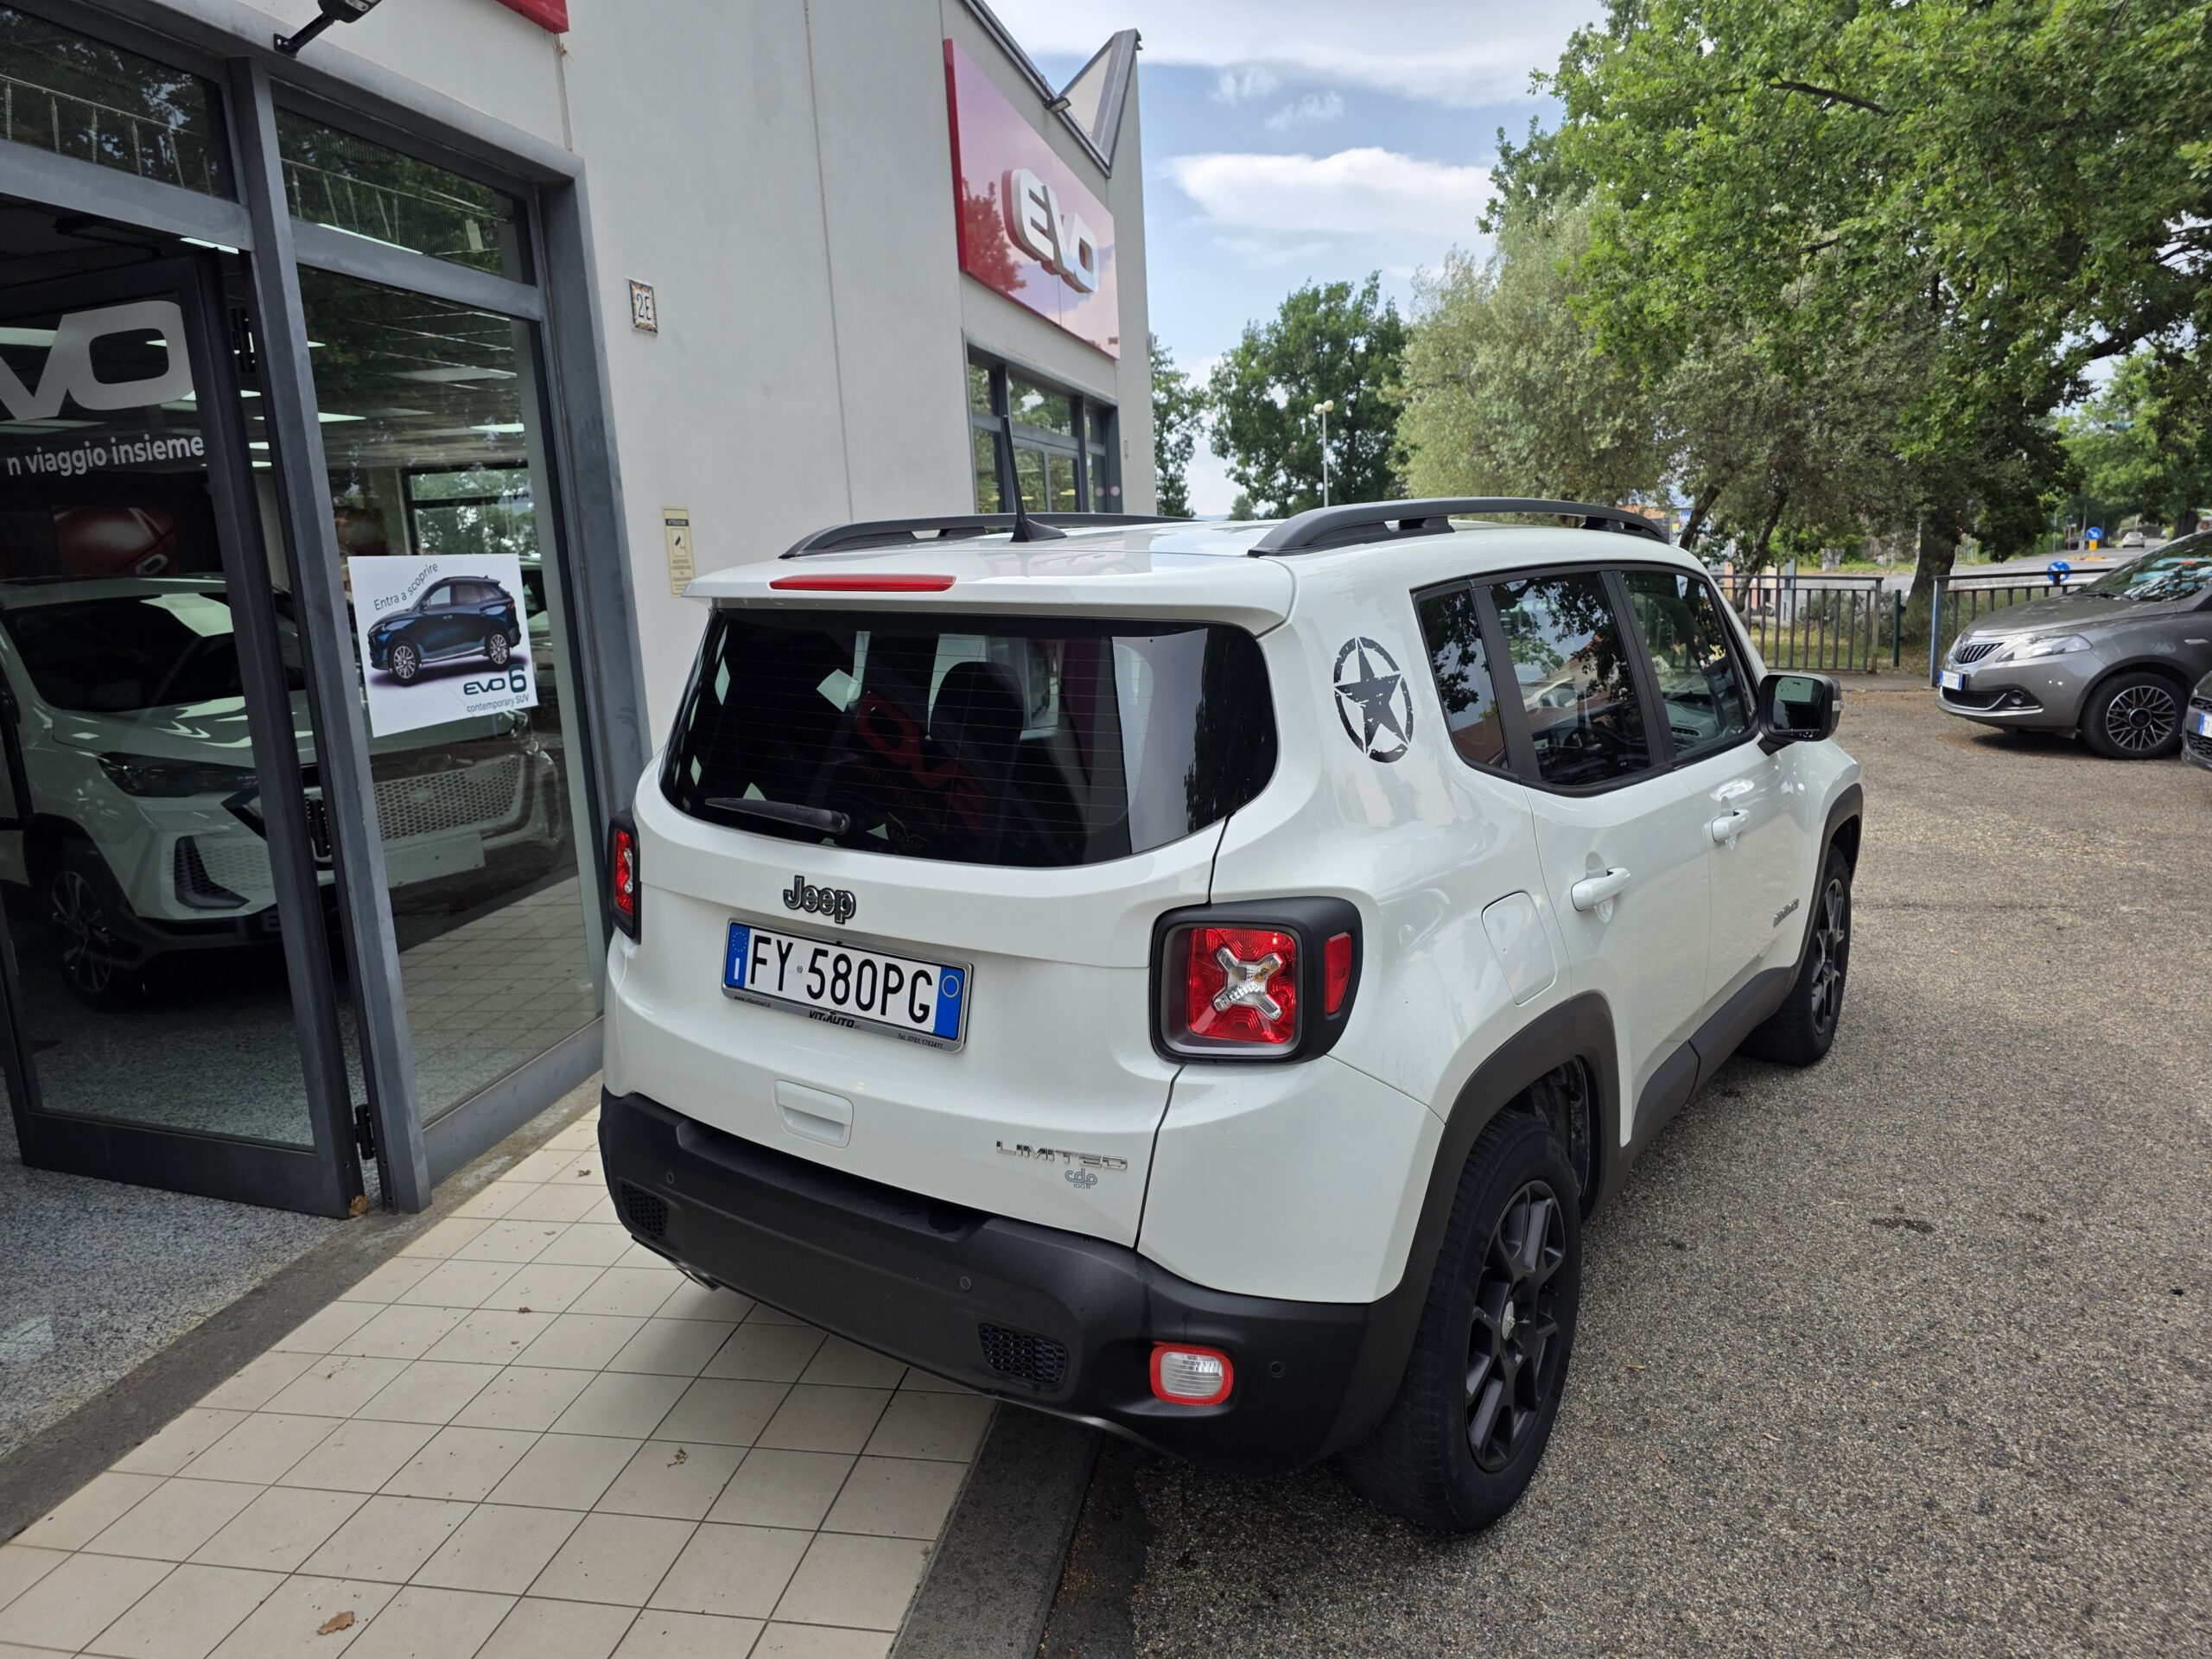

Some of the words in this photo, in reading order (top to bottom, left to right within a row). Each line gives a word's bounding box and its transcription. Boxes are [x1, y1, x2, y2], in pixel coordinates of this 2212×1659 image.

[1013, 168, 1100, 293] EVO
[636, 292, 652, 321] 2E
[25, 441, 107, 477] viaggio
[110, 434, 205, 465] insieme
[373, 593, 400, 611] Entra
[401, 592, 407, 601] a
[408, 563, 439, 596] scoprire
[463, 677, 506, 696] EVO
[508, 664, 527, 694] 6
[467, 697, 515, 712] contemporary
[515, 693, 530, 704] SUV
[782, 874, 857, 925] Jeep
[749, 934, 794, 992] FY
[806, 948, 934, 1025] 580PG
[995, 1139, 1128, 1172] LIMITED
